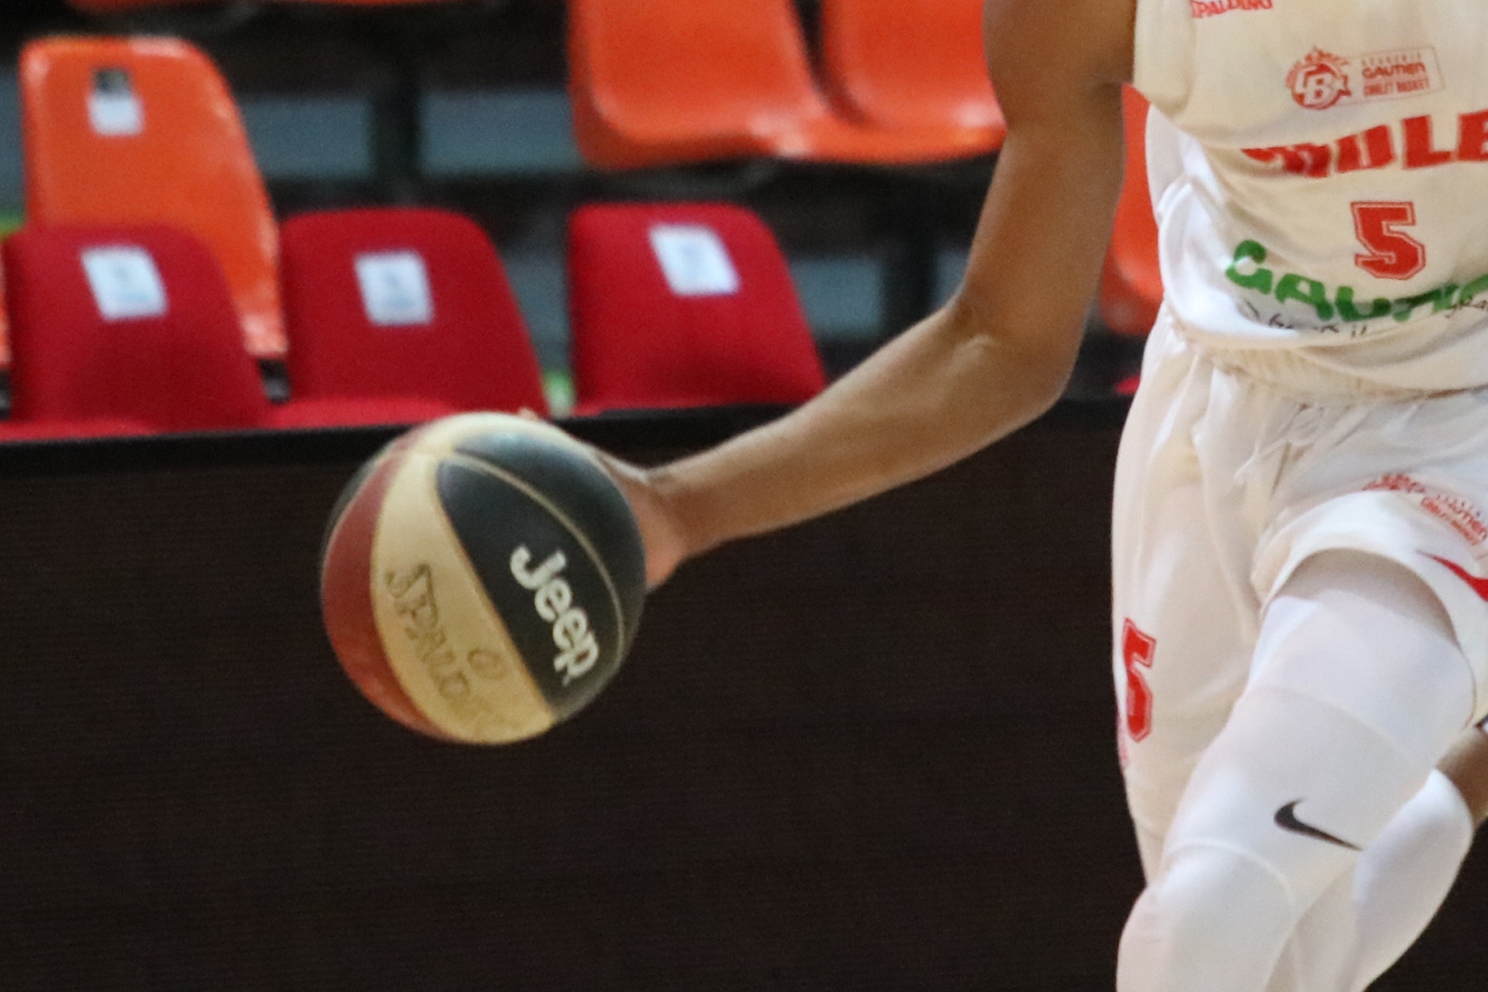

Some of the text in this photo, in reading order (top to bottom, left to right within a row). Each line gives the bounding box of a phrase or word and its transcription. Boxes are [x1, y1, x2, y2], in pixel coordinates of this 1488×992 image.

[1350, 200, 1426, 281] 5
[510, 546, 599, 686] Jeep
[1122, 616, 1157, 743] 5
